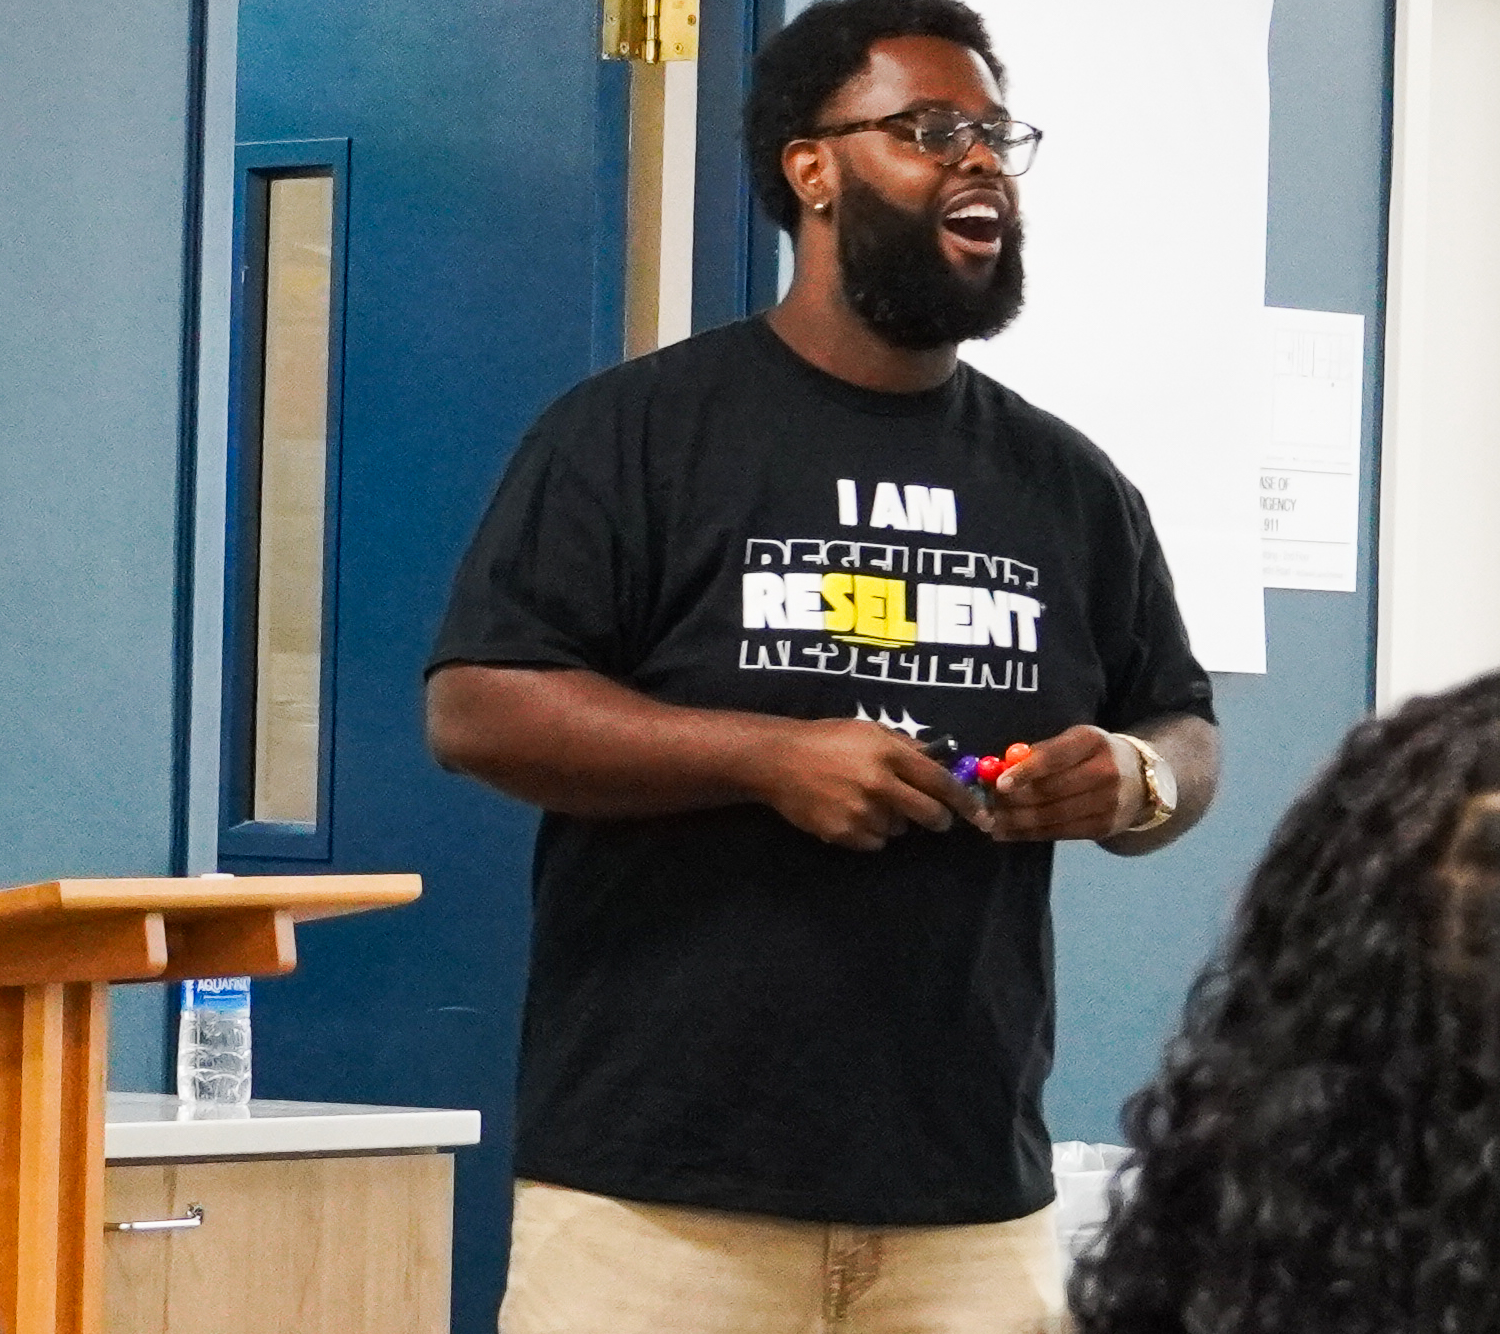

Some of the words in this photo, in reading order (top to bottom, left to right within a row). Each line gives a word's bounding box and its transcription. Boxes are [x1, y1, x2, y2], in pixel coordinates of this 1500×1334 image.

[836, 478, 858, 527] I
[869, 481, 958, 536] AM
[1263, 518, 1279, 533] 911
[742, 571, 1041, 653] RESELIENT
